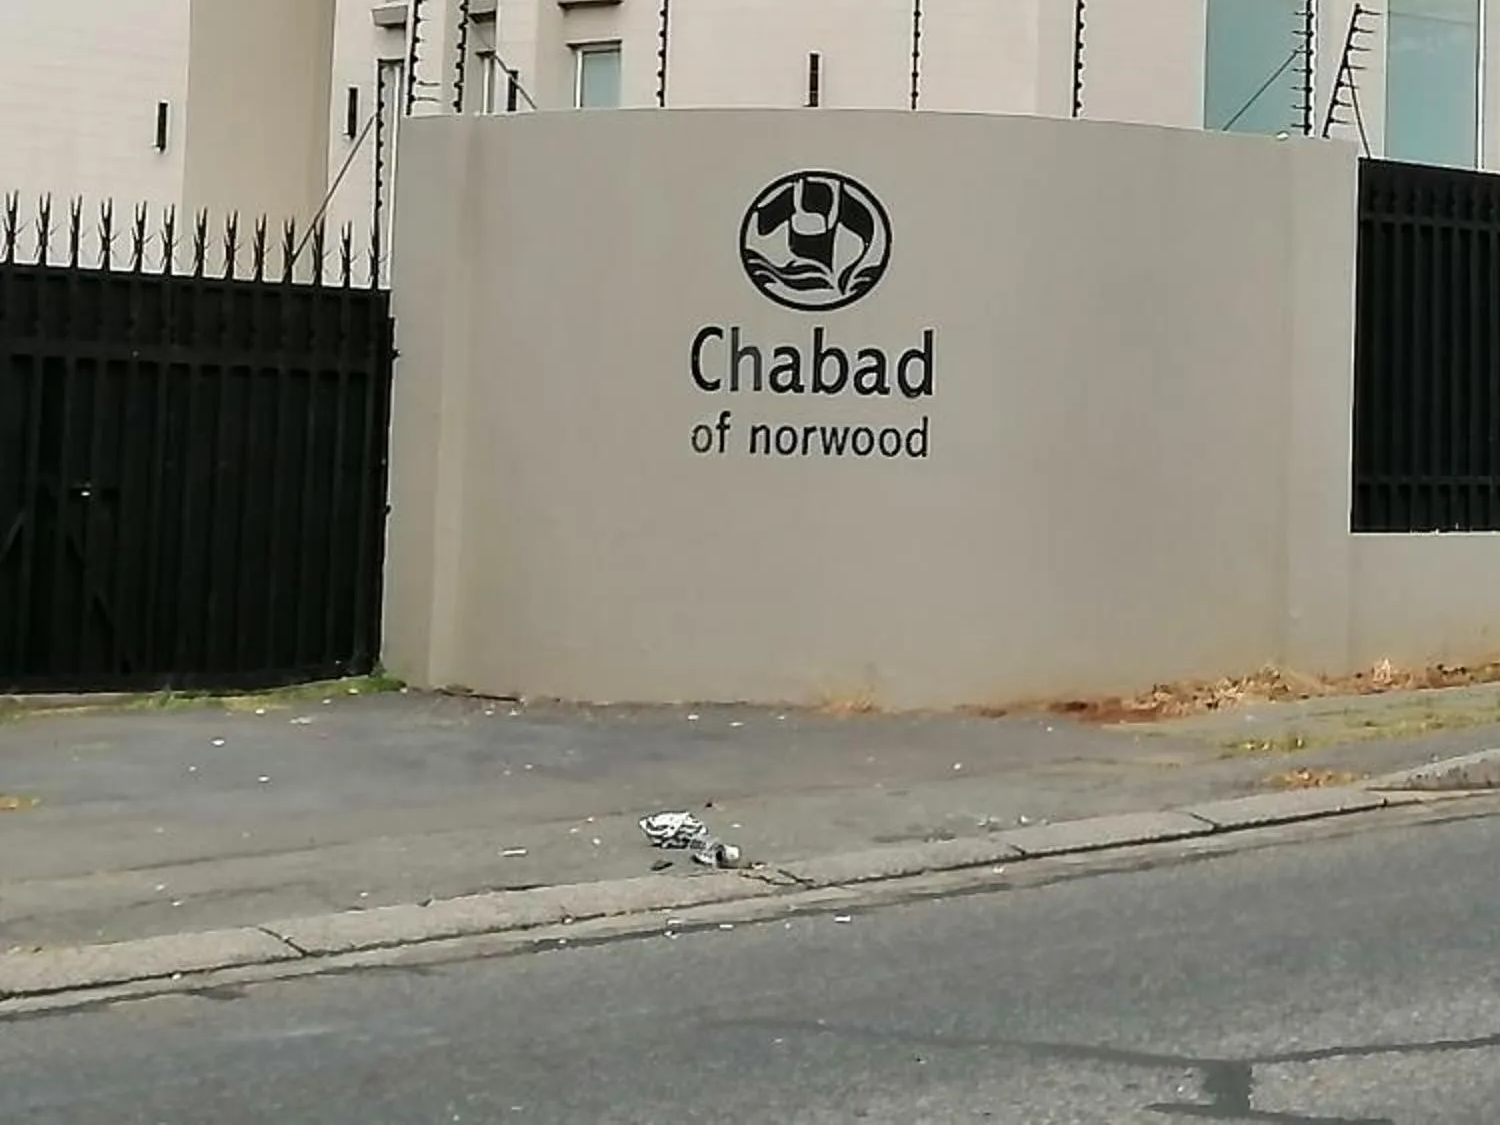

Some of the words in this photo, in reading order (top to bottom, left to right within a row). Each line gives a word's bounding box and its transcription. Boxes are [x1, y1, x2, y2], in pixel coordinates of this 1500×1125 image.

[691, 326, 934, 399] Chabad
[691, 410, 731, 454] of
[750, 416, 929, 458] norwood
